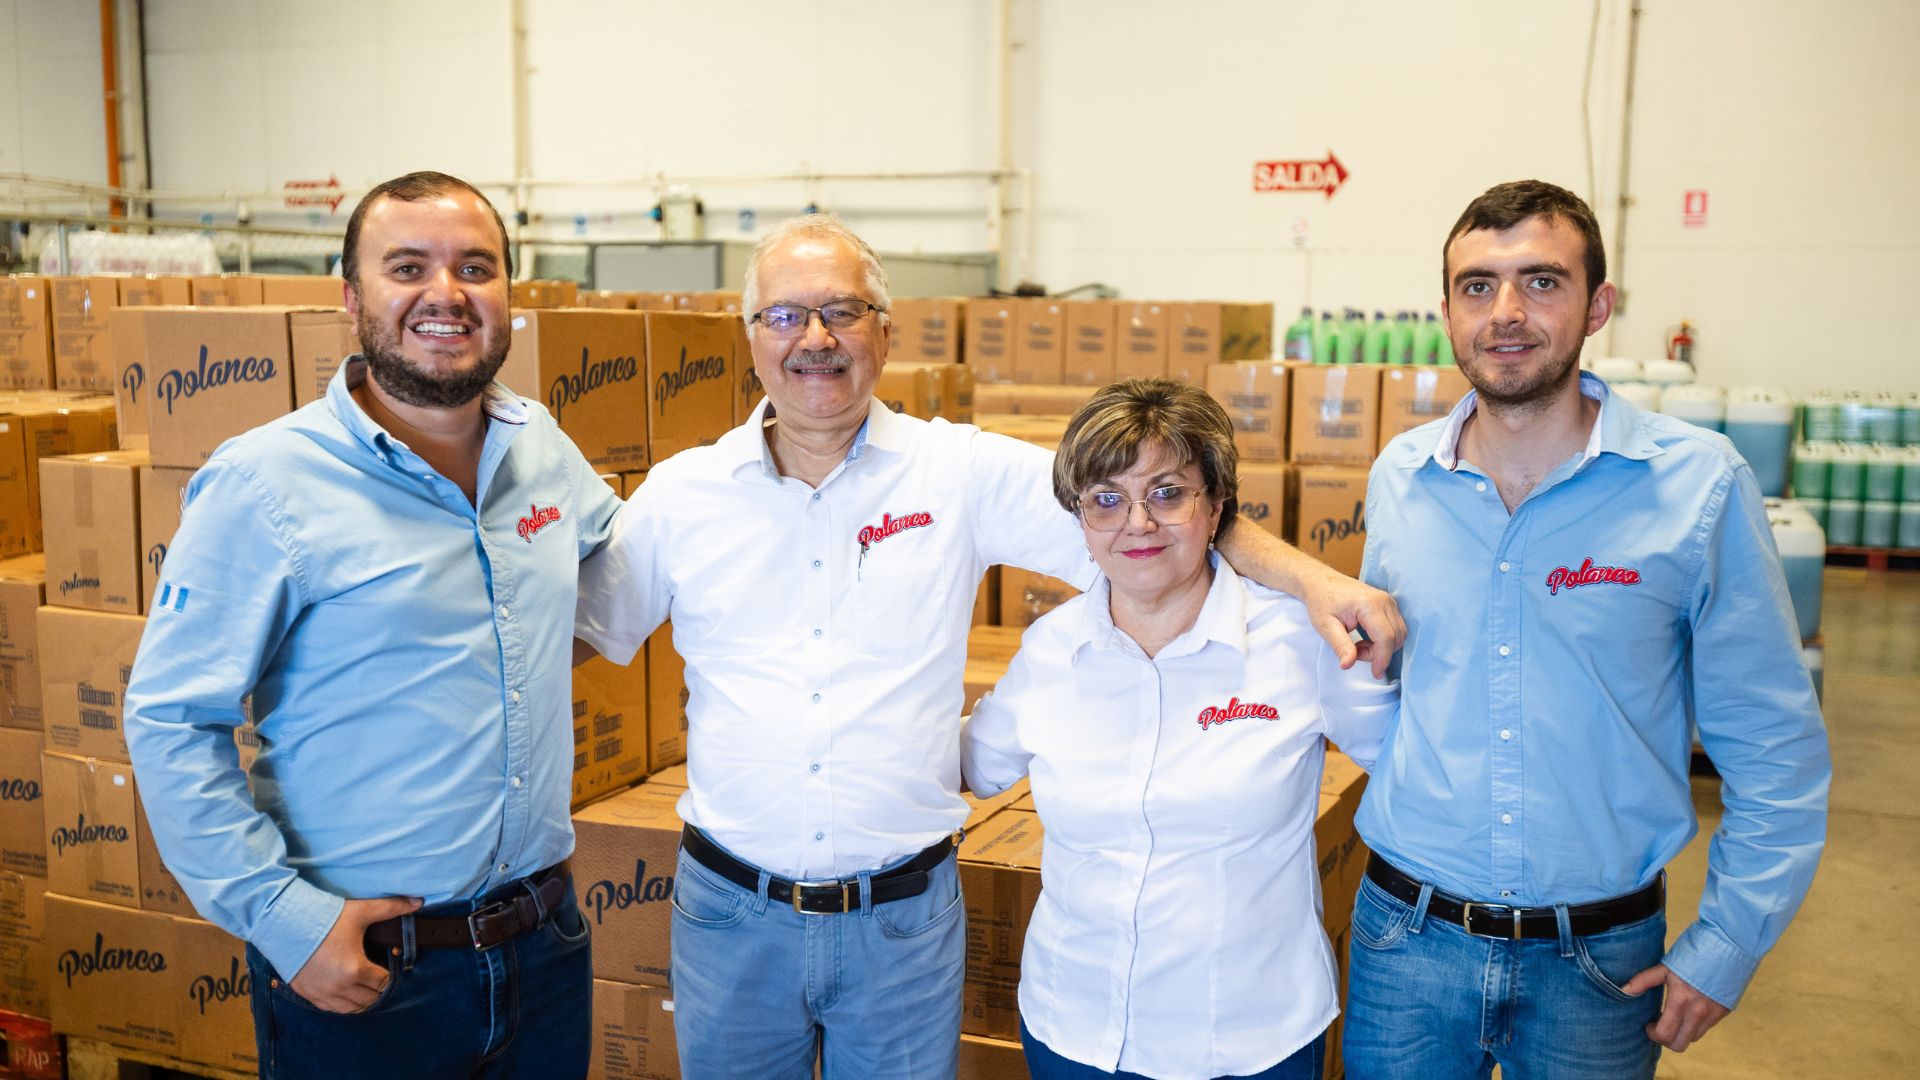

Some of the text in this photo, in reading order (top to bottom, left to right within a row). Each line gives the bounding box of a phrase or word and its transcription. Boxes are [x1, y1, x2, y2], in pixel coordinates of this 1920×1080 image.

[1256, 163, 1338, 188] SALIDA
[157, 345, 277, 415] Polanco
[549, 346, 638, 424] Polanco
[655, 345, 726, 416] Polanco
[517, 503, 561, 543] Polanco
[857, 512, 934, 550] Polanco
[1311, 500, 1367, 552] Pol
[1547, 557, 1641, 596] Polanco
[1197, 696, 1280, 730] Polanco
[52, 813, 129, 858] Polanco
[58, 932, 167, 989] Polanco
